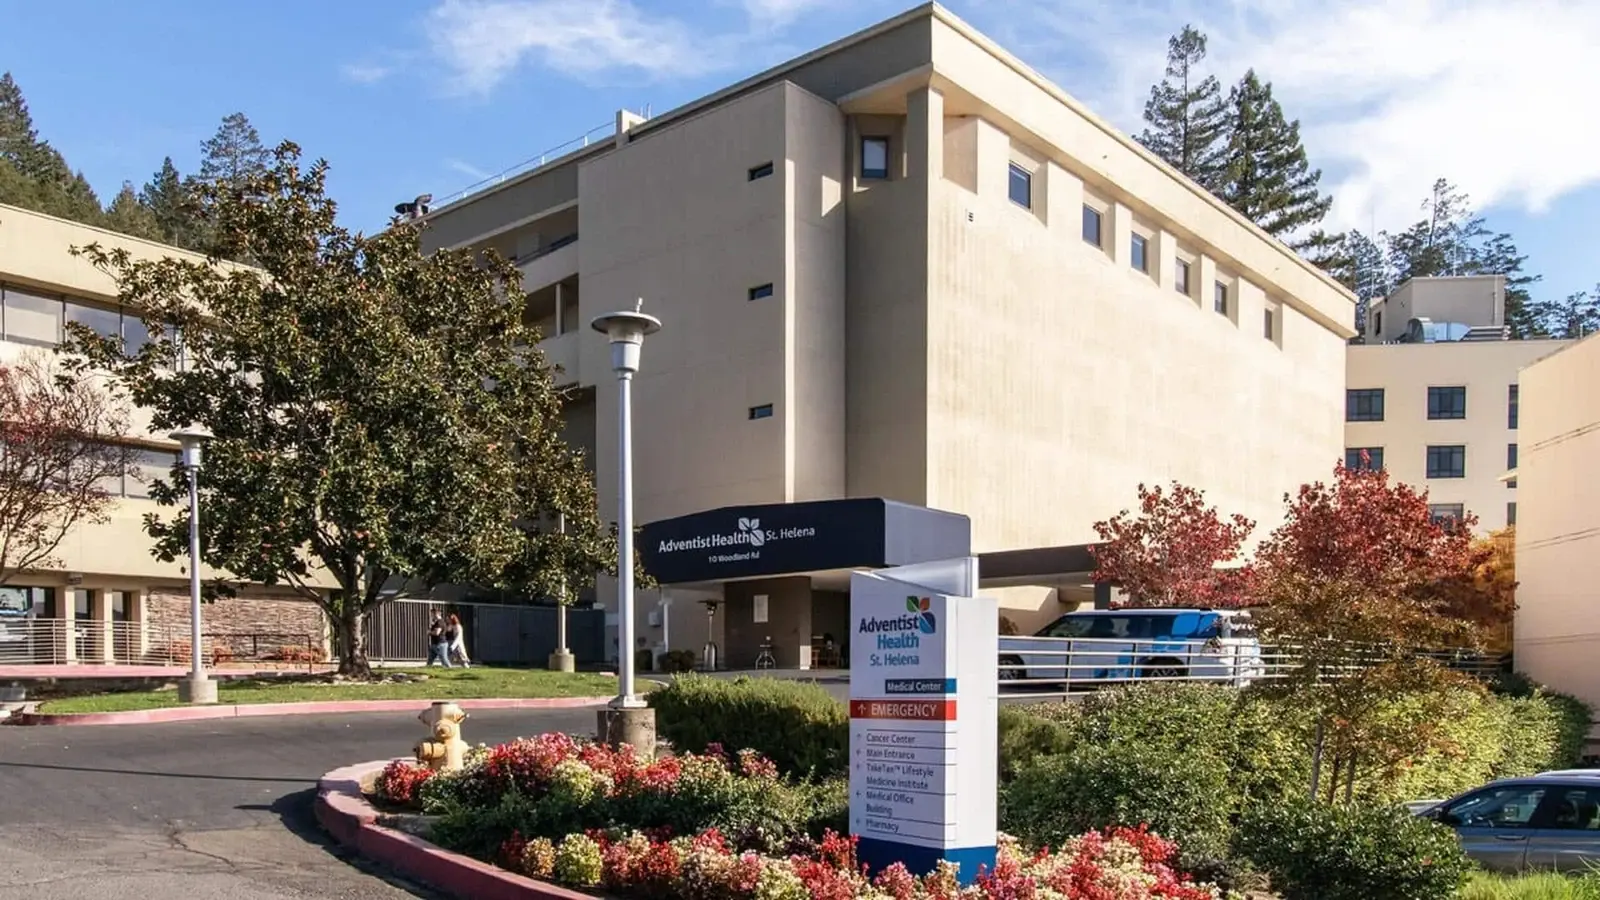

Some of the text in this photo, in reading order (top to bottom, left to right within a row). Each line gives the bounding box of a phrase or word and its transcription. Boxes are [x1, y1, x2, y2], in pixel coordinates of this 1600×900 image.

[658, 527, 815, 553] Adventist Health St. Helena
[709, 555, 718, 563] 10
[718, 552, 750, 562] Woodland
[859, 615, 919, 633] Adventist
[877, 632, 919, 650] Health
[869, 653, 919, 667] St. Helena
[887, 682, 941, 692] Medical Center
[871, 703, 937, 717] EMERGENCY
[866, 733, 915, 744] Cancer Center
[866, 748, 915, 759] Main Entrance
[902, 766, 934, 778] Lifestyle
[866, 776, 928, 789] Medicine Institute
[866, 791, 914, 804] Medical Office
[866, 803, 892, 816] Building
[866, 819, 899, 833] Pharmacy
